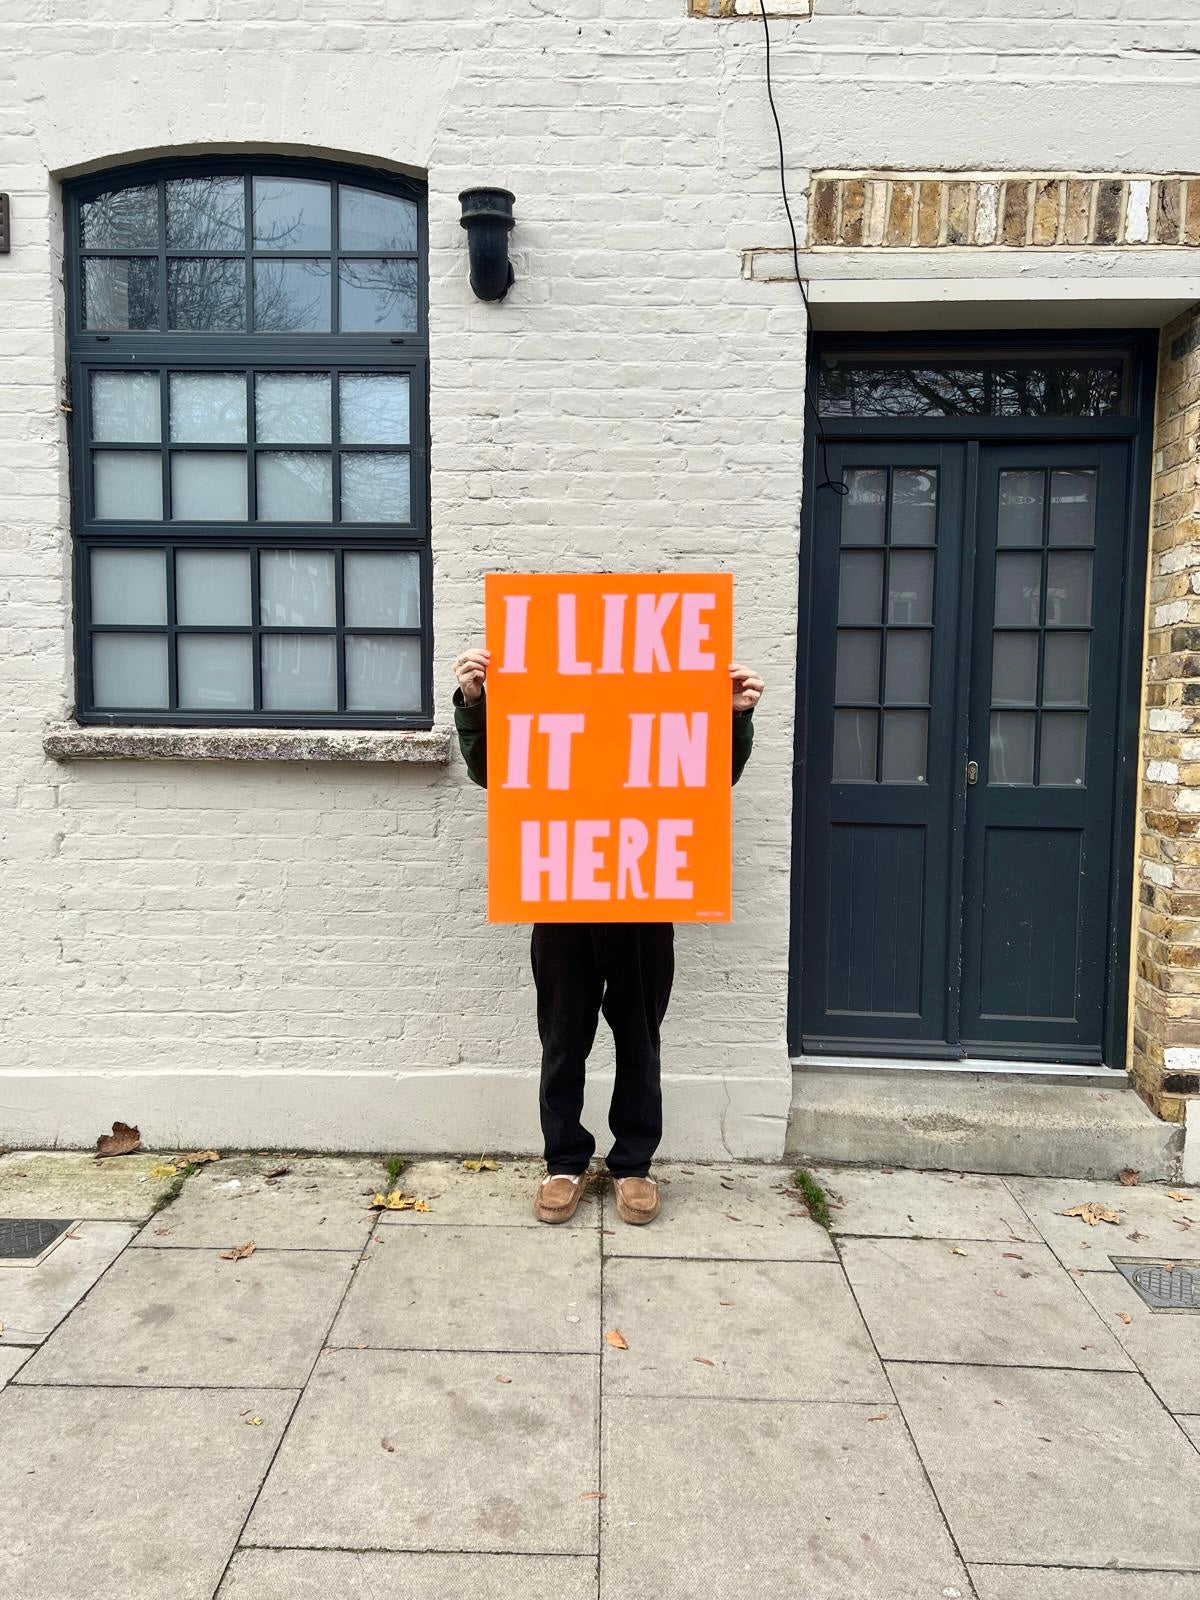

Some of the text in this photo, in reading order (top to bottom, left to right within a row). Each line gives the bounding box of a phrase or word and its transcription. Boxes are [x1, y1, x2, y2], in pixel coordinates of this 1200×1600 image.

[498, 592, 716, 675] I LIKE
[501, 712, 709, 790] IT IN
[520, 818, 694, 902] HERE
